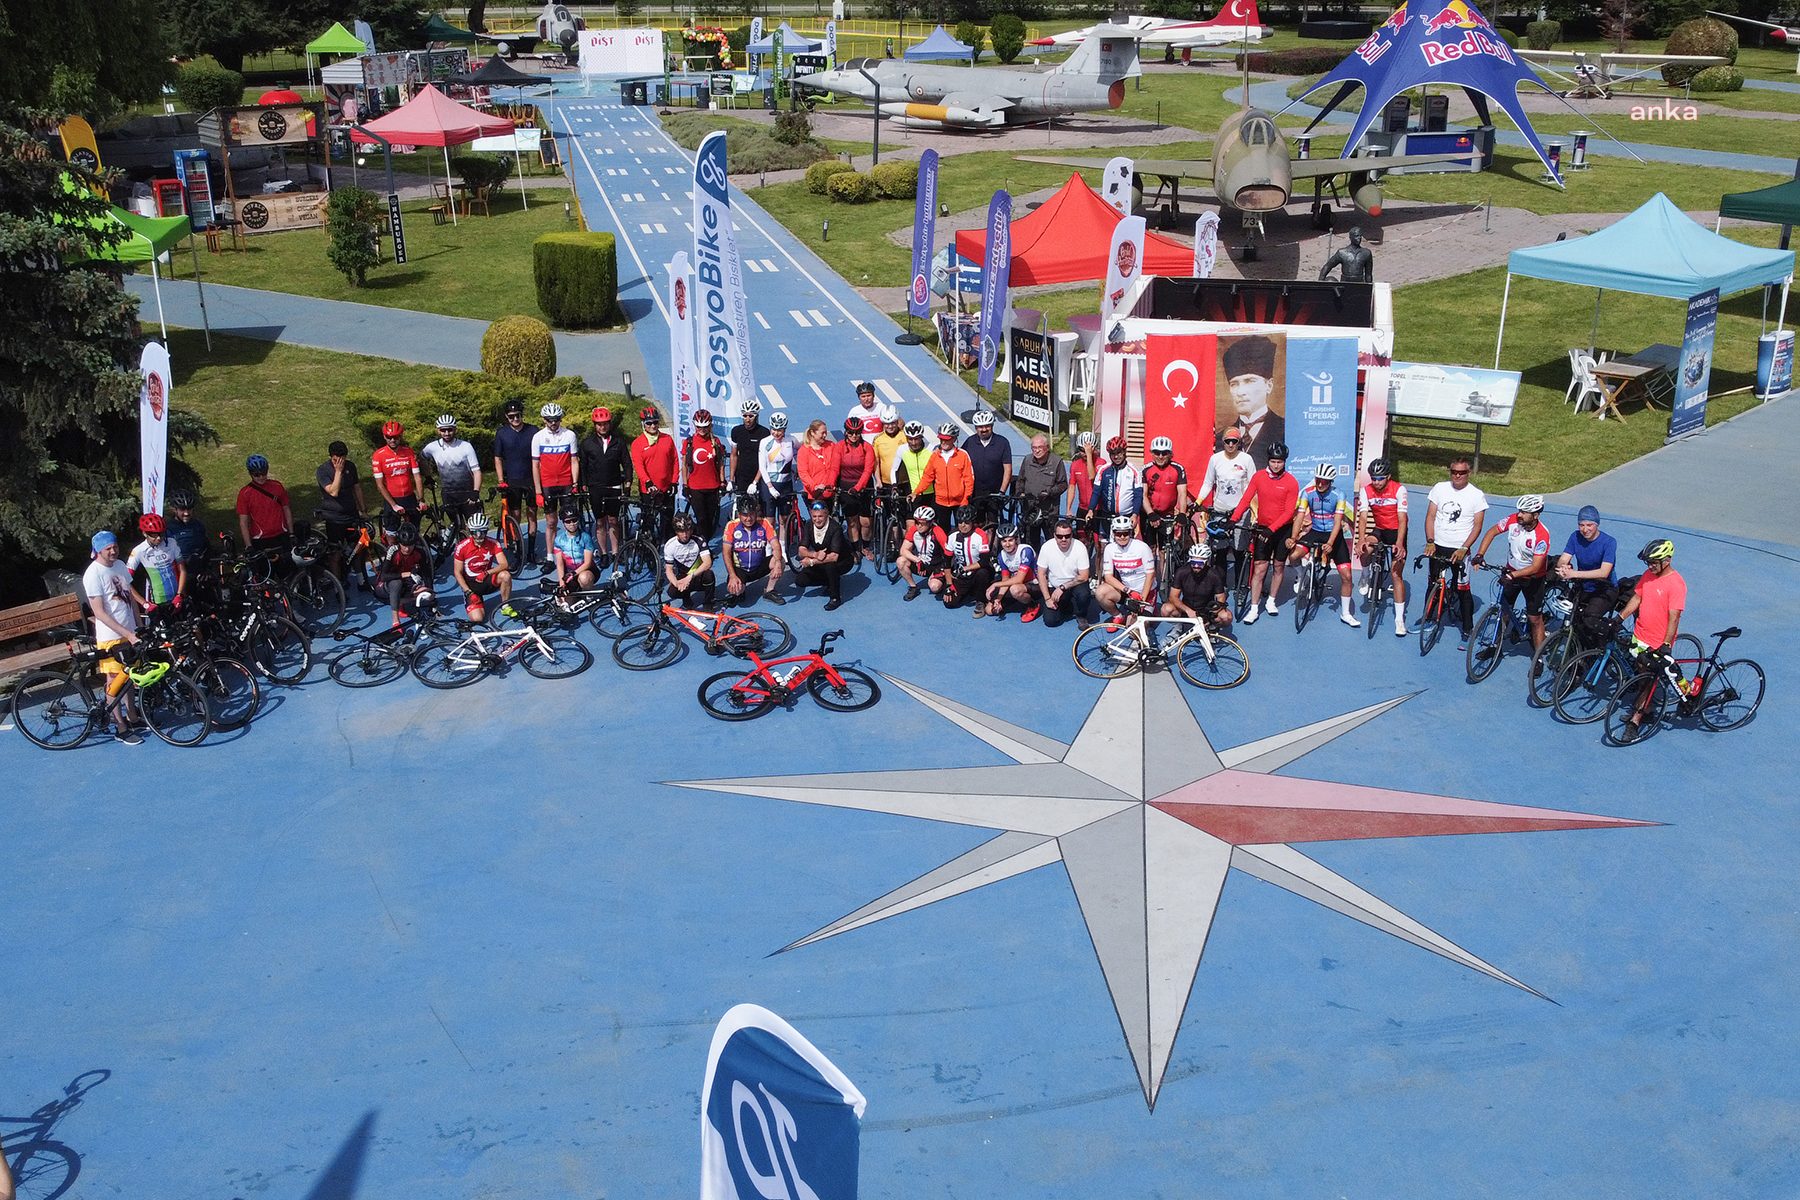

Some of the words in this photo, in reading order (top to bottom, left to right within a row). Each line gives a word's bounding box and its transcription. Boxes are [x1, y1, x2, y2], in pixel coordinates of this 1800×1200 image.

[1355, 31, 1392, 66] Bull
[1420, 30, 1482, 66] Red
[1476, 32, 1516, 66] Bull
[751, 52, 759, 74] PTİK
[392, 206, 404, 263] HAMBURGER
[698, 204, 734, 402] SosyoBike
[1015, 375, 1050, 397] AJANS
[1015, 403, 1029, 416] 220
[1029, 407, 1040, 419] 03
[1303, 411, 1340, 420] TEPEBAŞI
[1308, 405, 1335, 413] ESKİŞEHİR
[543, 445, 568, 453] BTK
[385, 460, 410, 468] TREK
